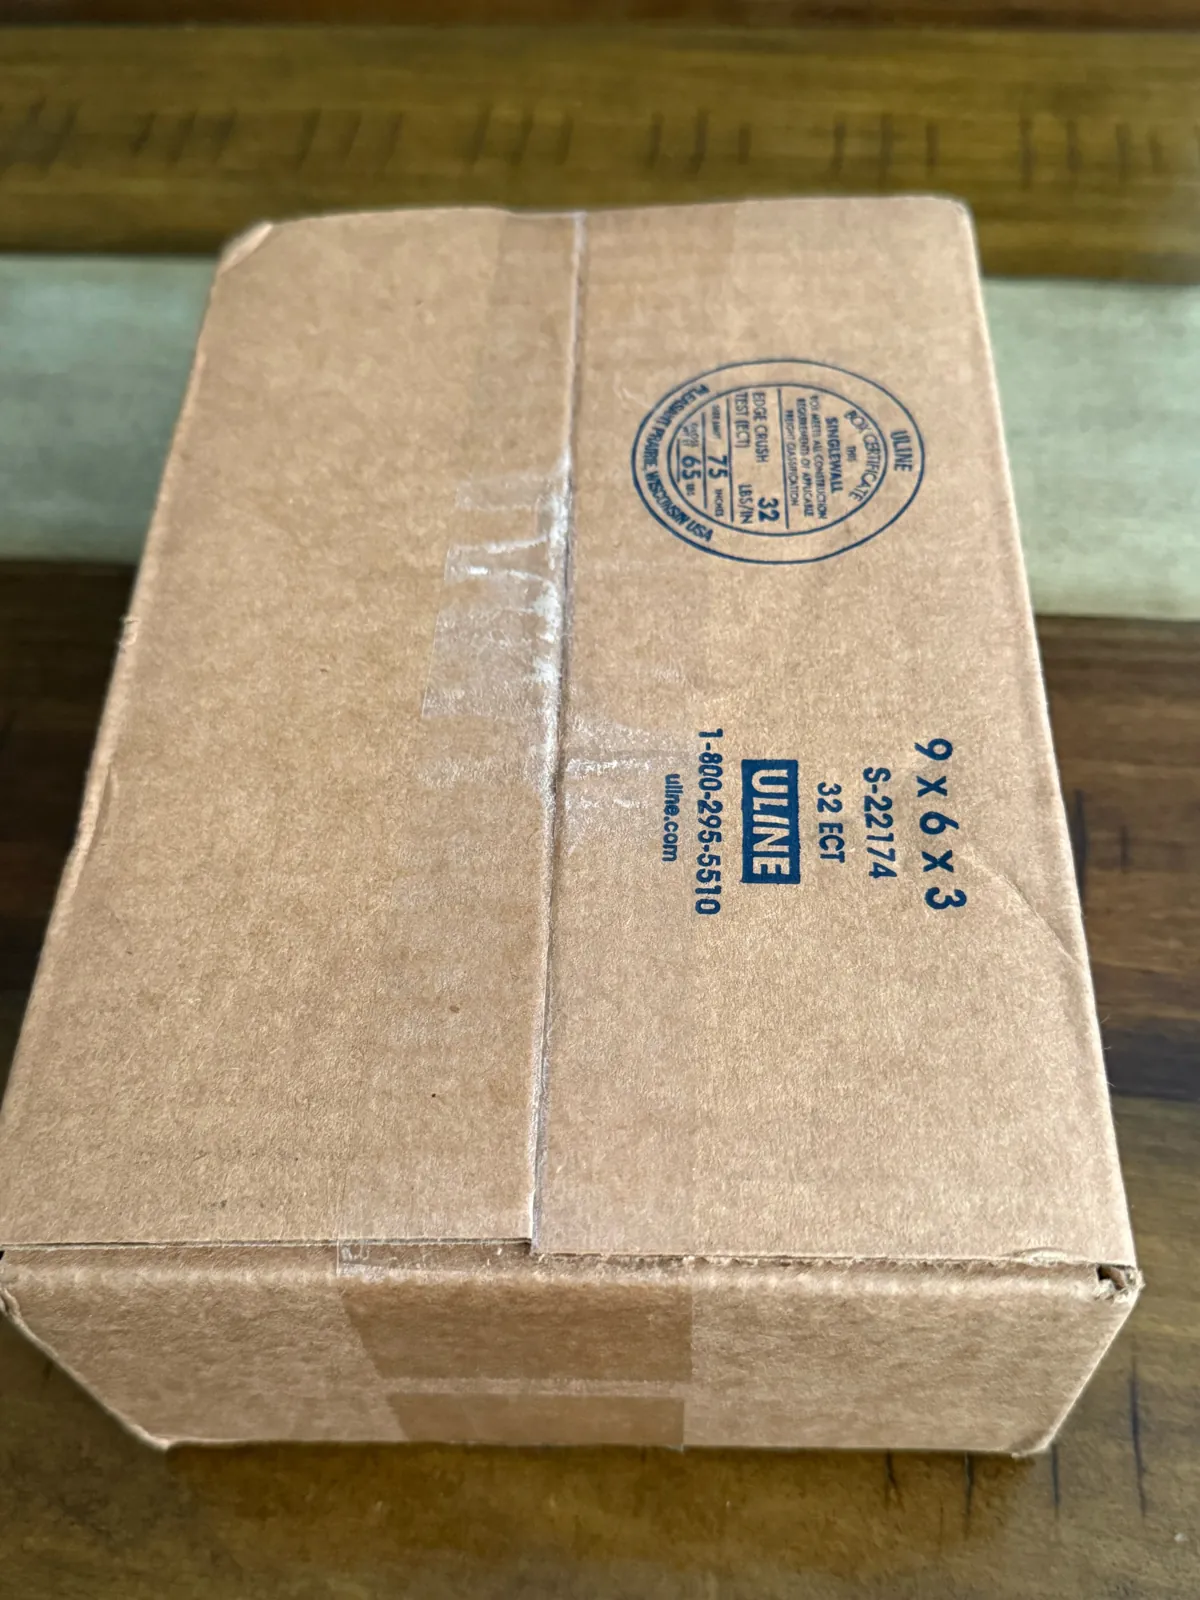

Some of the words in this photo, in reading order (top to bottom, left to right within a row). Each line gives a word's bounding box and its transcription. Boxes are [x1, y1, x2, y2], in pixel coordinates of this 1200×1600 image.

[656, 384, 709, 427] PLEASANT
[735, 392, 748, 415] TEST
[752, 392, 767, 420] EDGE
[844, 410, 870, 434] BOX
[735, 420, 750, 448] (ECT)
[755, 425, 769, 463] CRUSH
[813, 441, 823, 452] ALL
[890, 430, 913, 472] ULINE
[682, 456, 701, 480] 65
[708, 455, 728, 479] 75
[787, 443, 798, 506] CLASSIFICATION
[825, 418, 842, 493] SINGLEWALL
[849, 434, 880, 501] CERTIFICATE
[645, 470, 690, 525] WISCONSIN
[715, 489, 724, 517] INCHES
[738, 484, 753, 524] LBS/IN
[803, 473, 813, 517] APPLICABLE
[814, 454, 827, 519] CONSTRUCTION
[759, 497, 780, 522] 32
[686, 521, 713, 542] USA
[915, 738, 953, 761] 9
[817, 782, 842, 813] 32
[661, 773, 683, 862] uline.com
[695, 728, 723, 915] 1-800-295-5510
[752, 768, 790, 876] ULINE
[863, 767, 897, 879] S-22174
[920, 811, 960, 835] 6
[819, 822, 845, 863] ECT
[925, 886, 967, 910] 3
